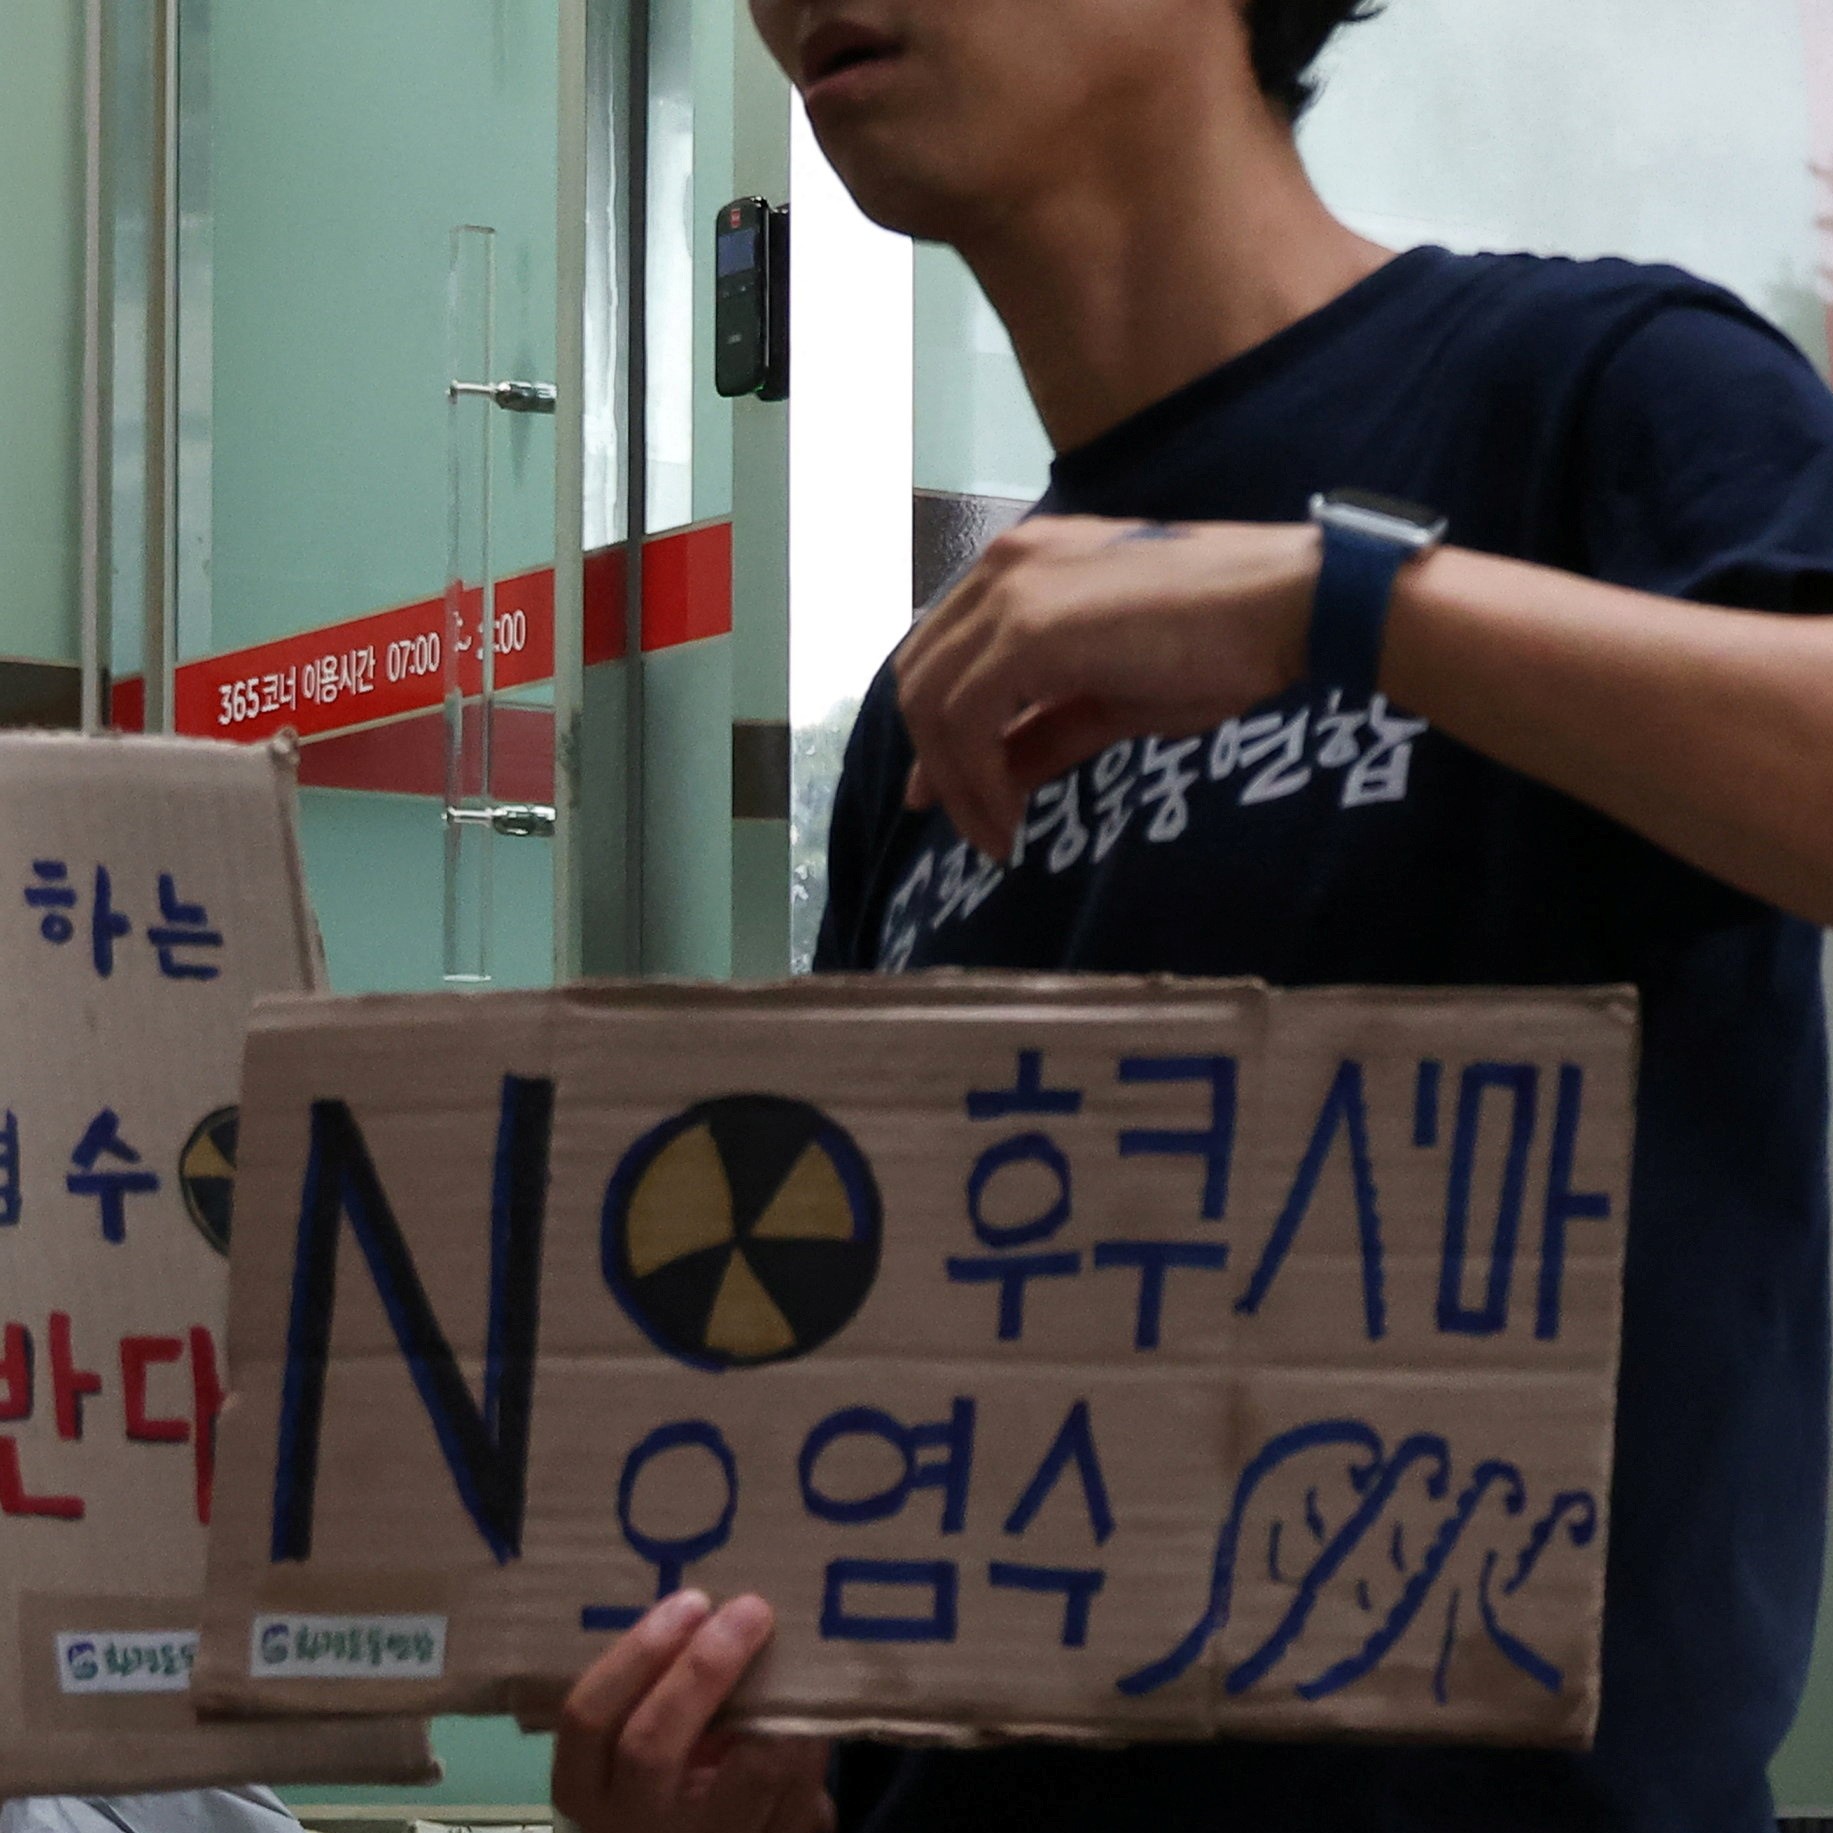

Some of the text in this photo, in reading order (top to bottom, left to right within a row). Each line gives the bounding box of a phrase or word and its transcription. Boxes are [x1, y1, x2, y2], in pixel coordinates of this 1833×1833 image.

[217, 665, 297, 725] 365코너
[301, 644, 377, 706] 이용시간
[385, 631, 441, 683] 07:00
[945, 1049, 1611, 1352] 후쿠시마
[578, 1396, 1117, 1649] 오염수
